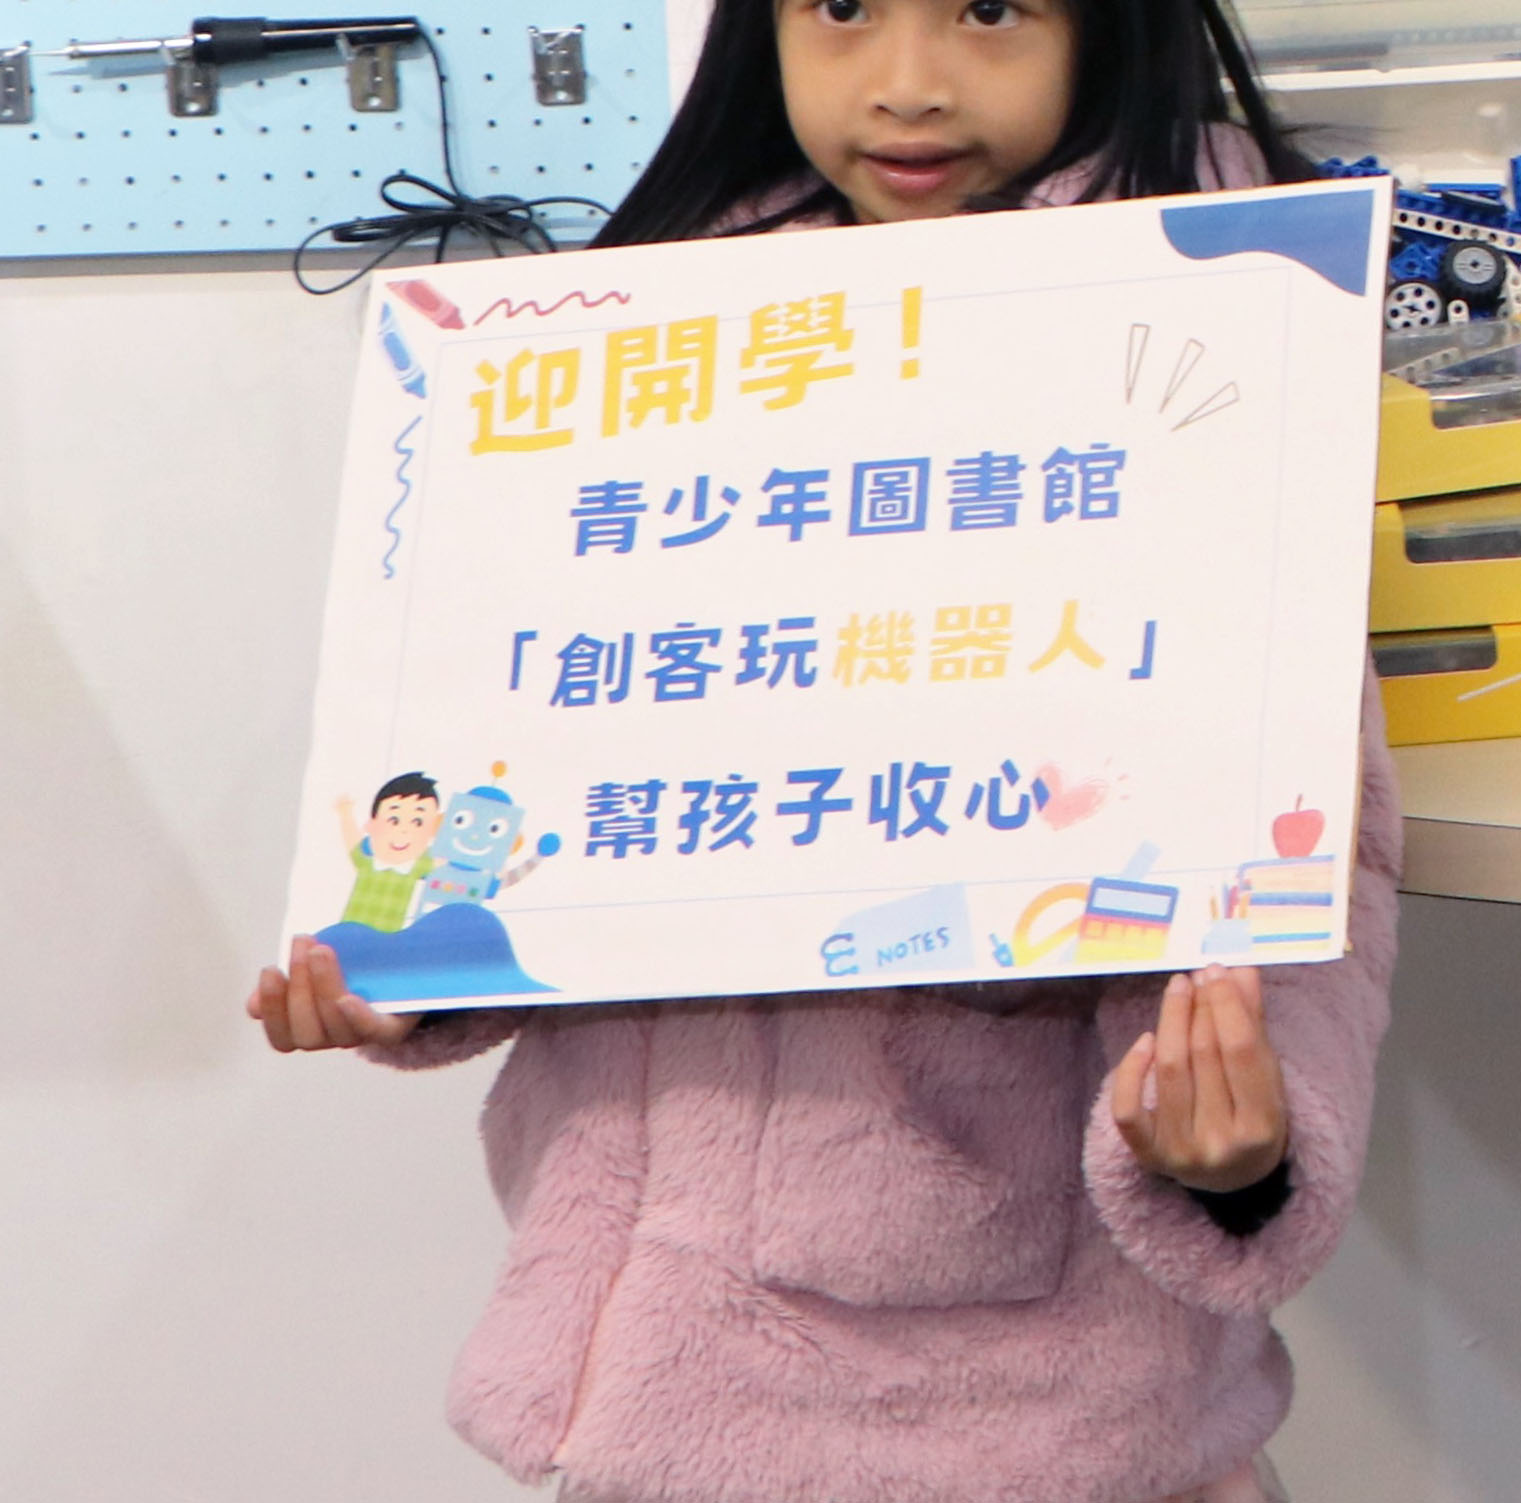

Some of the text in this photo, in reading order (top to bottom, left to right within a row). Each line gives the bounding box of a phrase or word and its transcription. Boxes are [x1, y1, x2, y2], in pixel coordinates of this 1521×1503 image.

[468, 285, 926, 457] 迎開學！
[569, 443, 1129, 557] 青少年圖書館
[506, 600, 1159, 709] 「創客玩機器人」
[581, 759, 1049, 862] 幫孩子收心
[877, 926, 950, 967] NOTES
